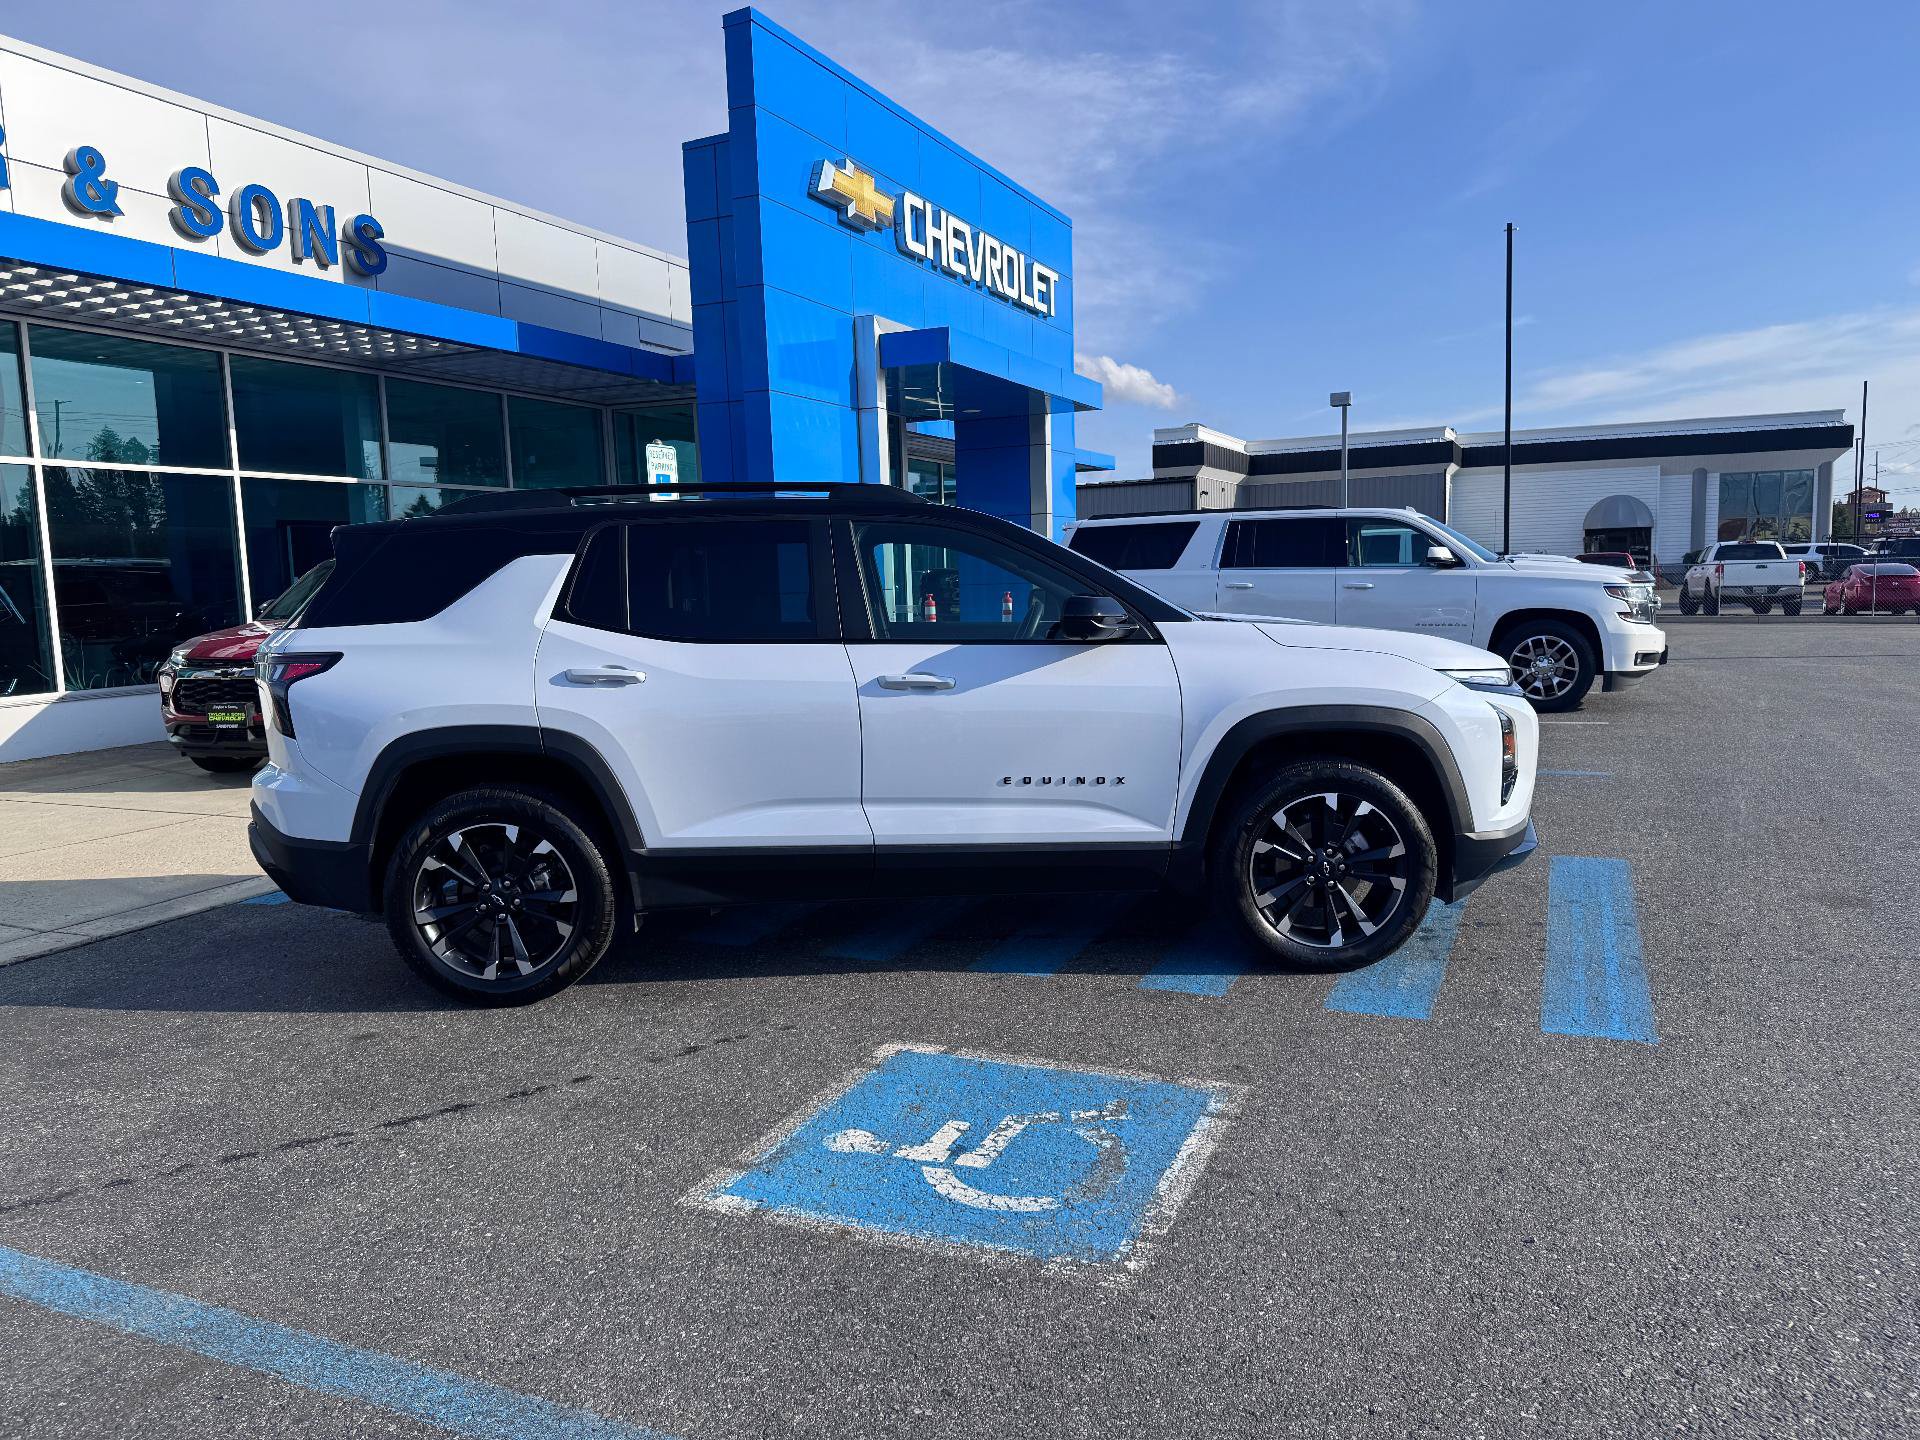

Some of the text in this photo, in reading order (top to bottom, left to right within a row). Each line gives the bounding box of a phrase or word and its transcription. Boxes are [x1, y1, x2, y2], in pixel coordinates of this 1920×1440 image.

[64, 145, 125, 219] &
[167, 166, 388, 276] SONS
[902, 191, 1059, 318] CHEVROLET
[1003, 776, 1126, 785] EQUINOX
